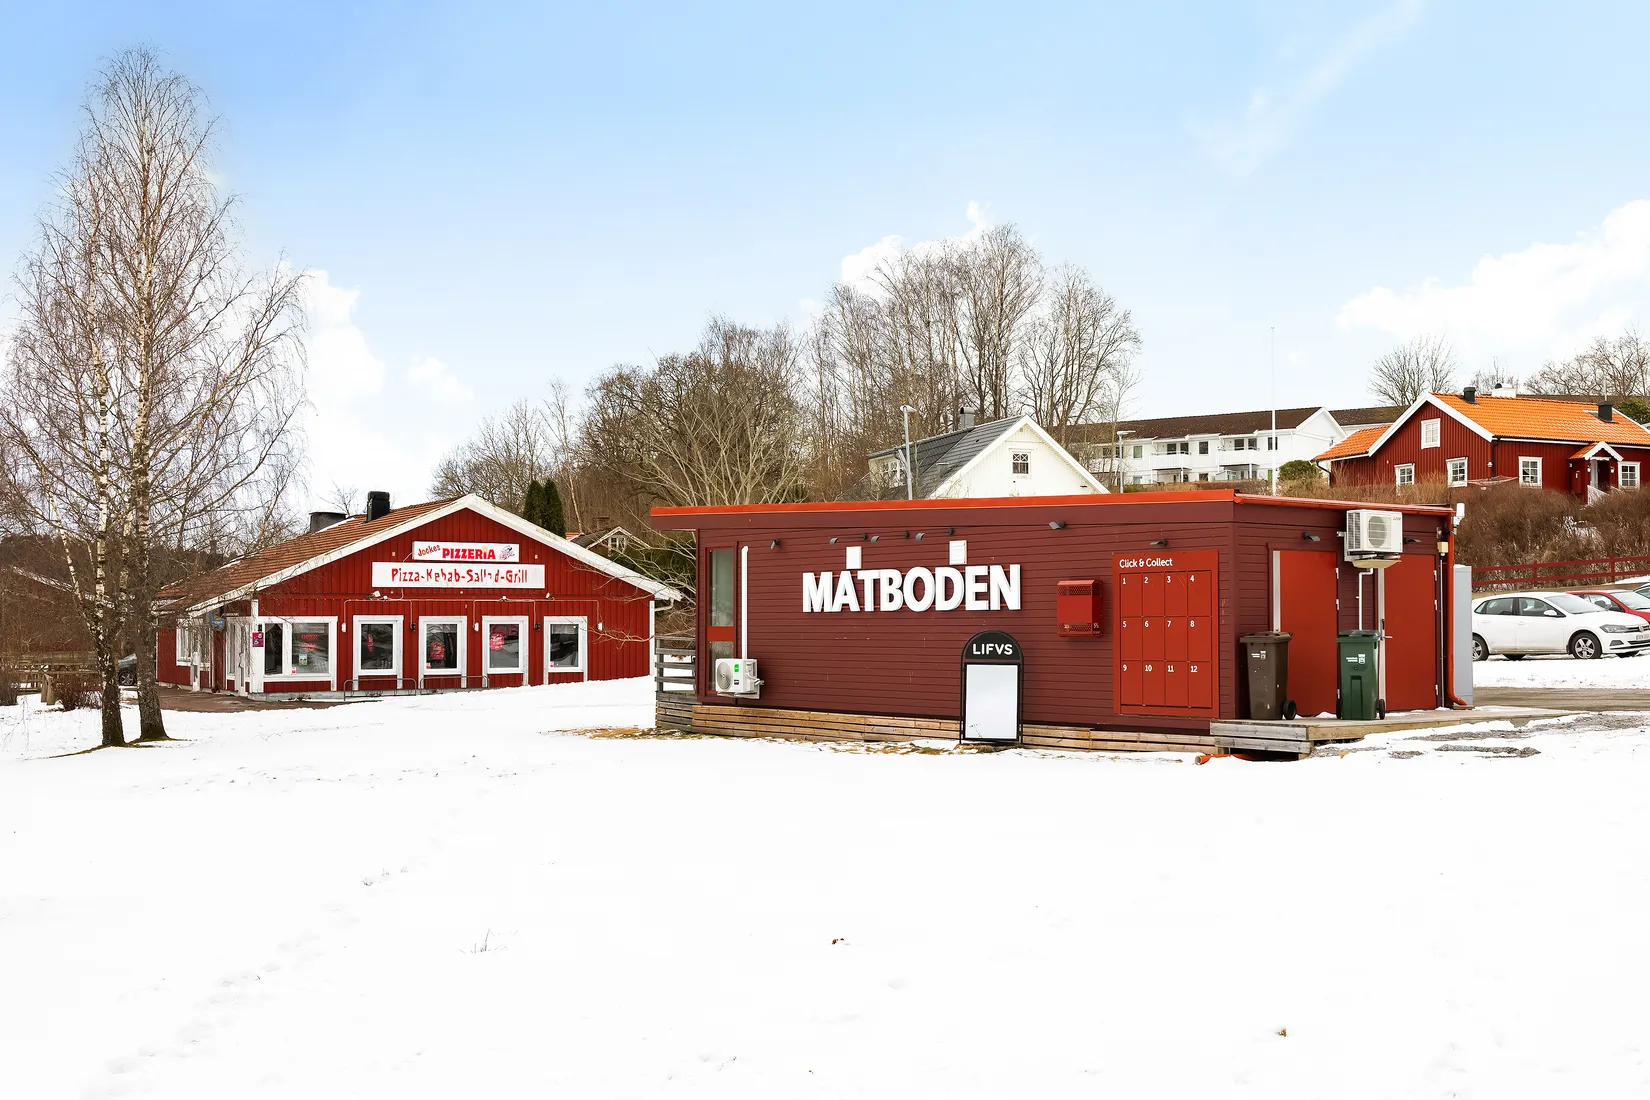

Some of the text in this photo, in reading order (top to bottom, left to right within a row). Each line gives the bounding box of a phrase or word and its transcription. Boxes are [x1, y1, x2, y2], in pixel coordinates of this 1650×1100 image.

[1120, 558, 1172, 568] Click & Collect
[802, 564, 1021, 612] MATBODEN
[972, 644, 1013, 655] LIFVS
